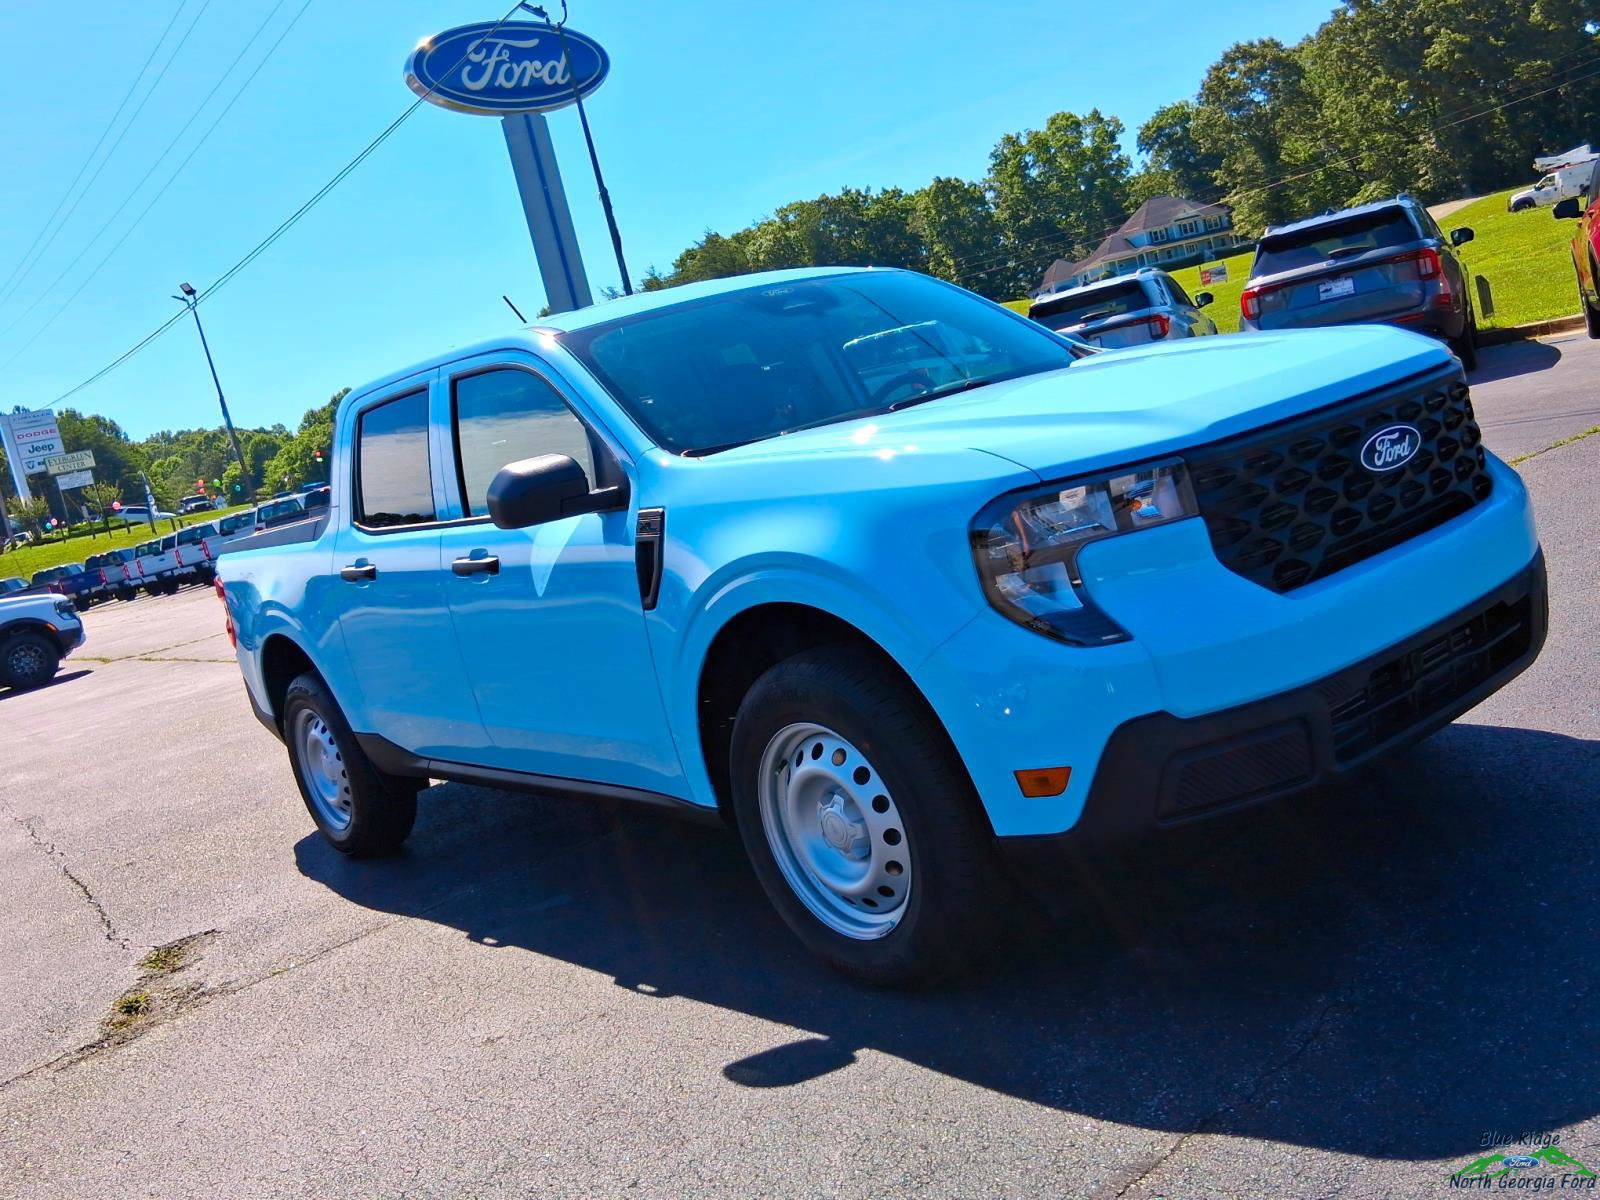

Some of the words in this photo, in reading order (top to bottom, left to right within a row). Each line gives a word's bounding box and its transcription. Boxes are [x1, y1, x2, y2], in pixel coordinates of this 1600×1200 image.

[461, 38, 571, 91] Ford
[16, 428, 57, 440] DODGE
[28, 443, 55, 454] Jeep
[1374, 431, 1411, 466] Ford
